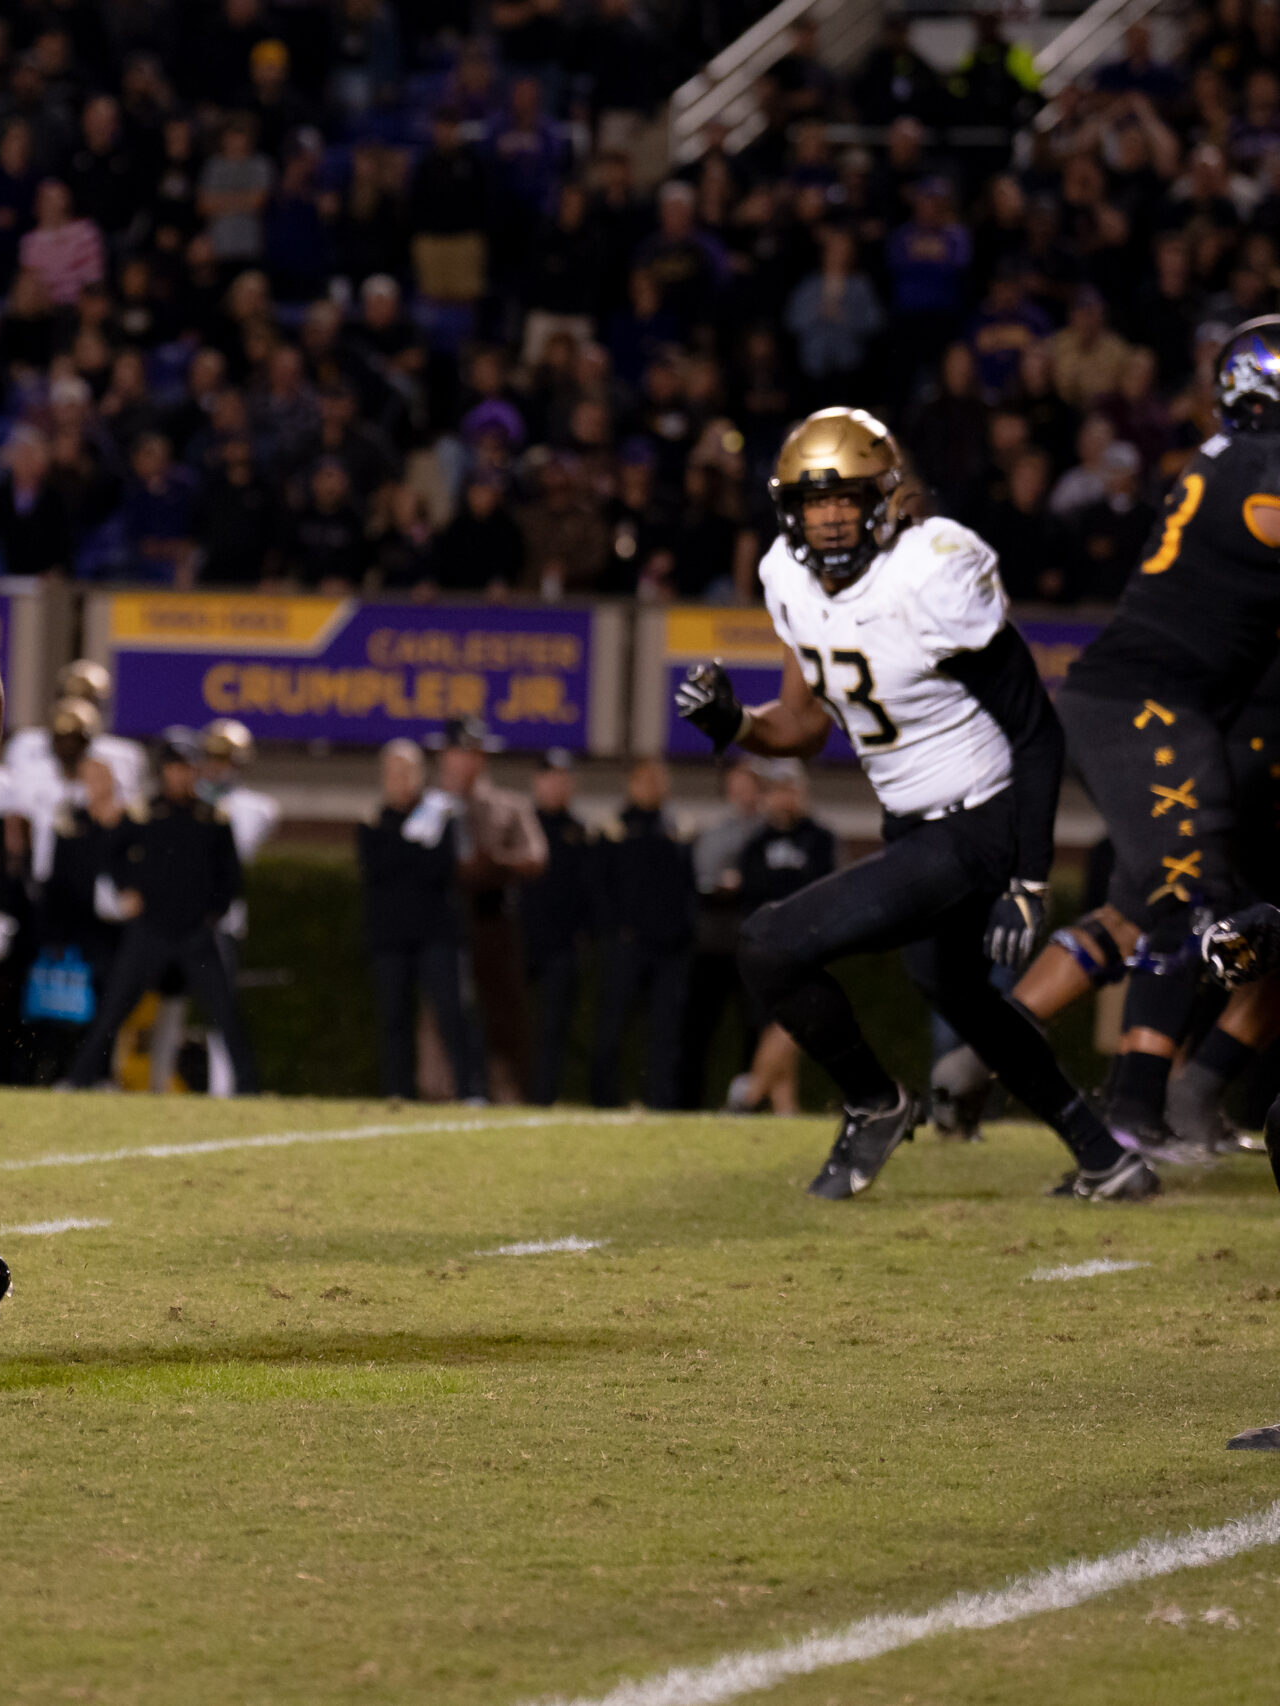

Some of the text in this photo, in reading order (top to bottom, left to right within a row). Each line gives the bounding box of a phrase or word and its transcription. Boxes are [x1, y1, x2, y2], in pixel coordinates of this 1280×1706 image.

[367, 628, 580, 670] CARLESTER
[202, 662, 579, 723] CRUMPLER JR.
